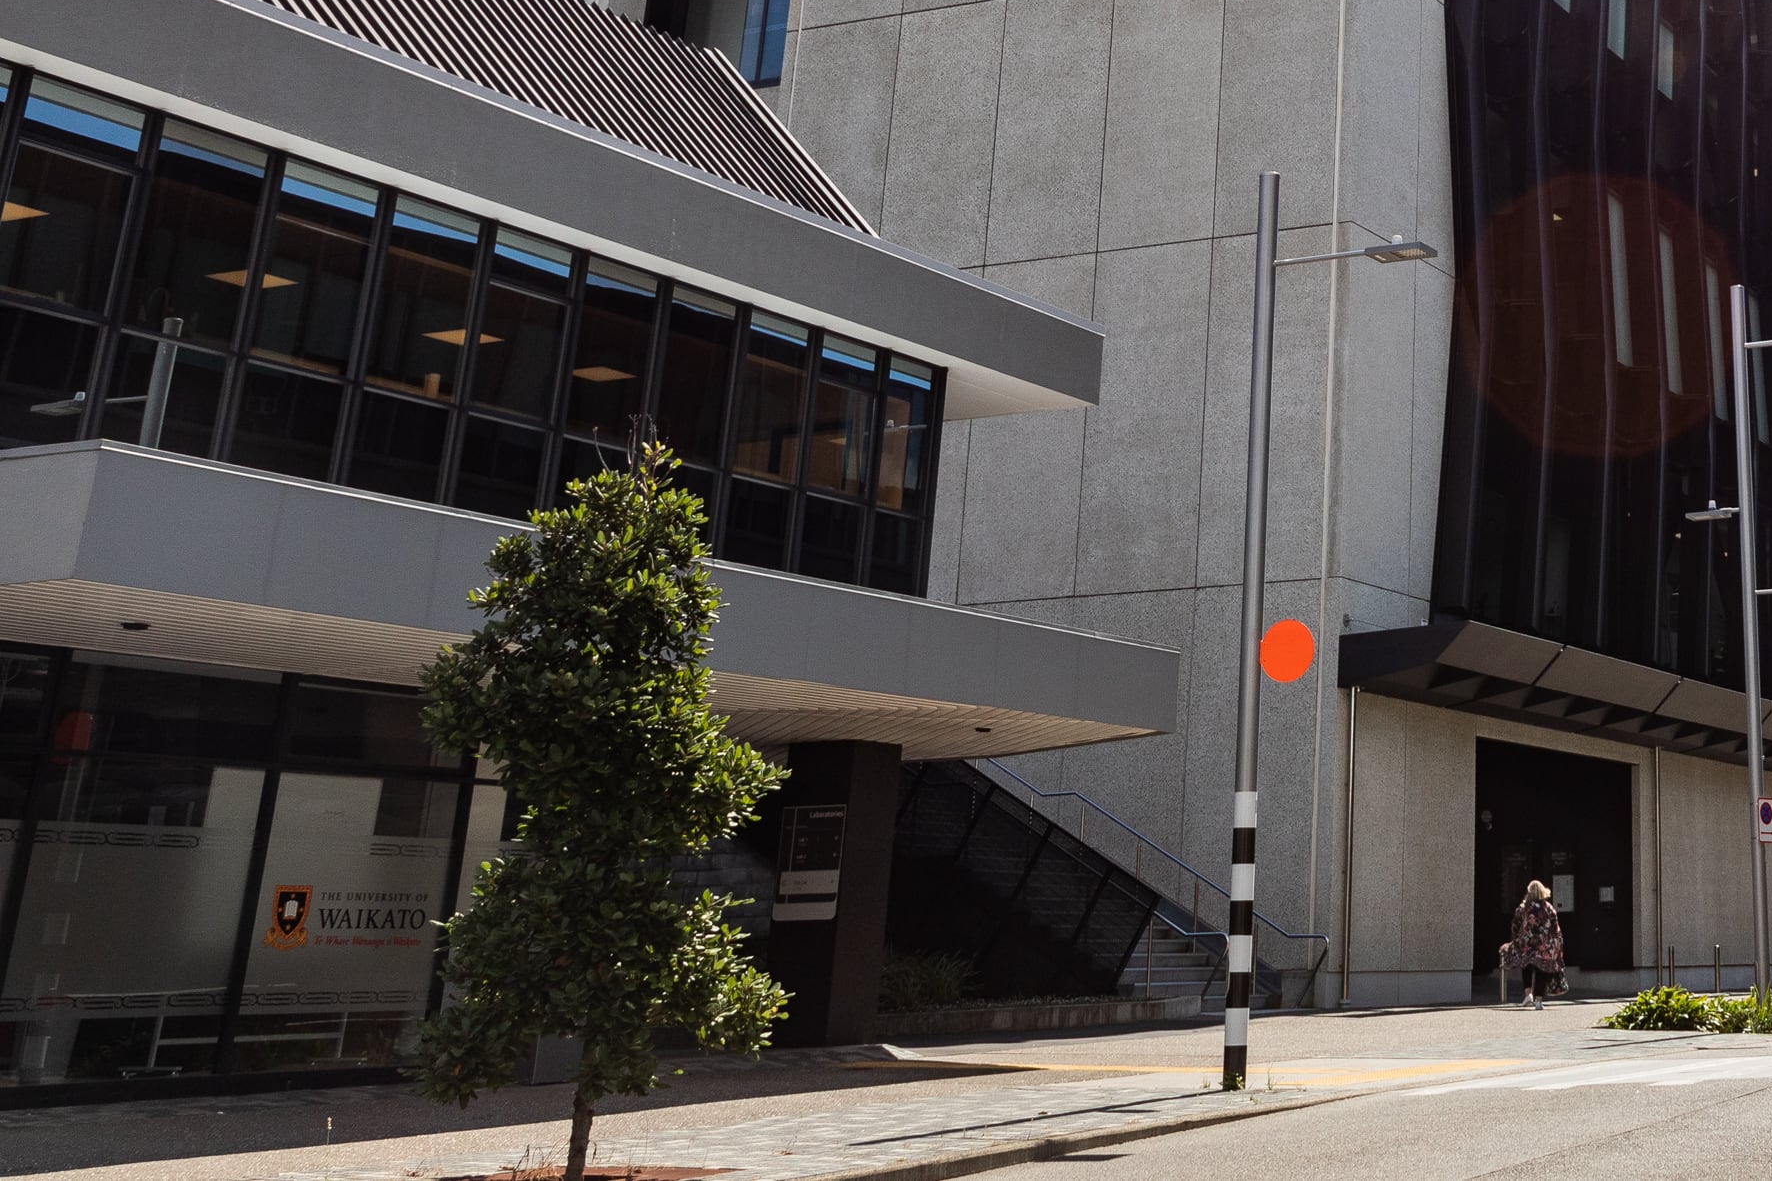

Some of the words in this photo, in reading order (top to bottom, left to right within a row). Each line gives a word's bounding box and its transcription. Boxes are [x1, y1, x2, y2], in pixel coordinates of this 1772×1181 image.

[321, 892, 341, 901] THE
[347, 892, 412, 902] UNIVERSITY
[416, 893, 428, 902] OF
[319, 908, 426, 930] WAIKATO
